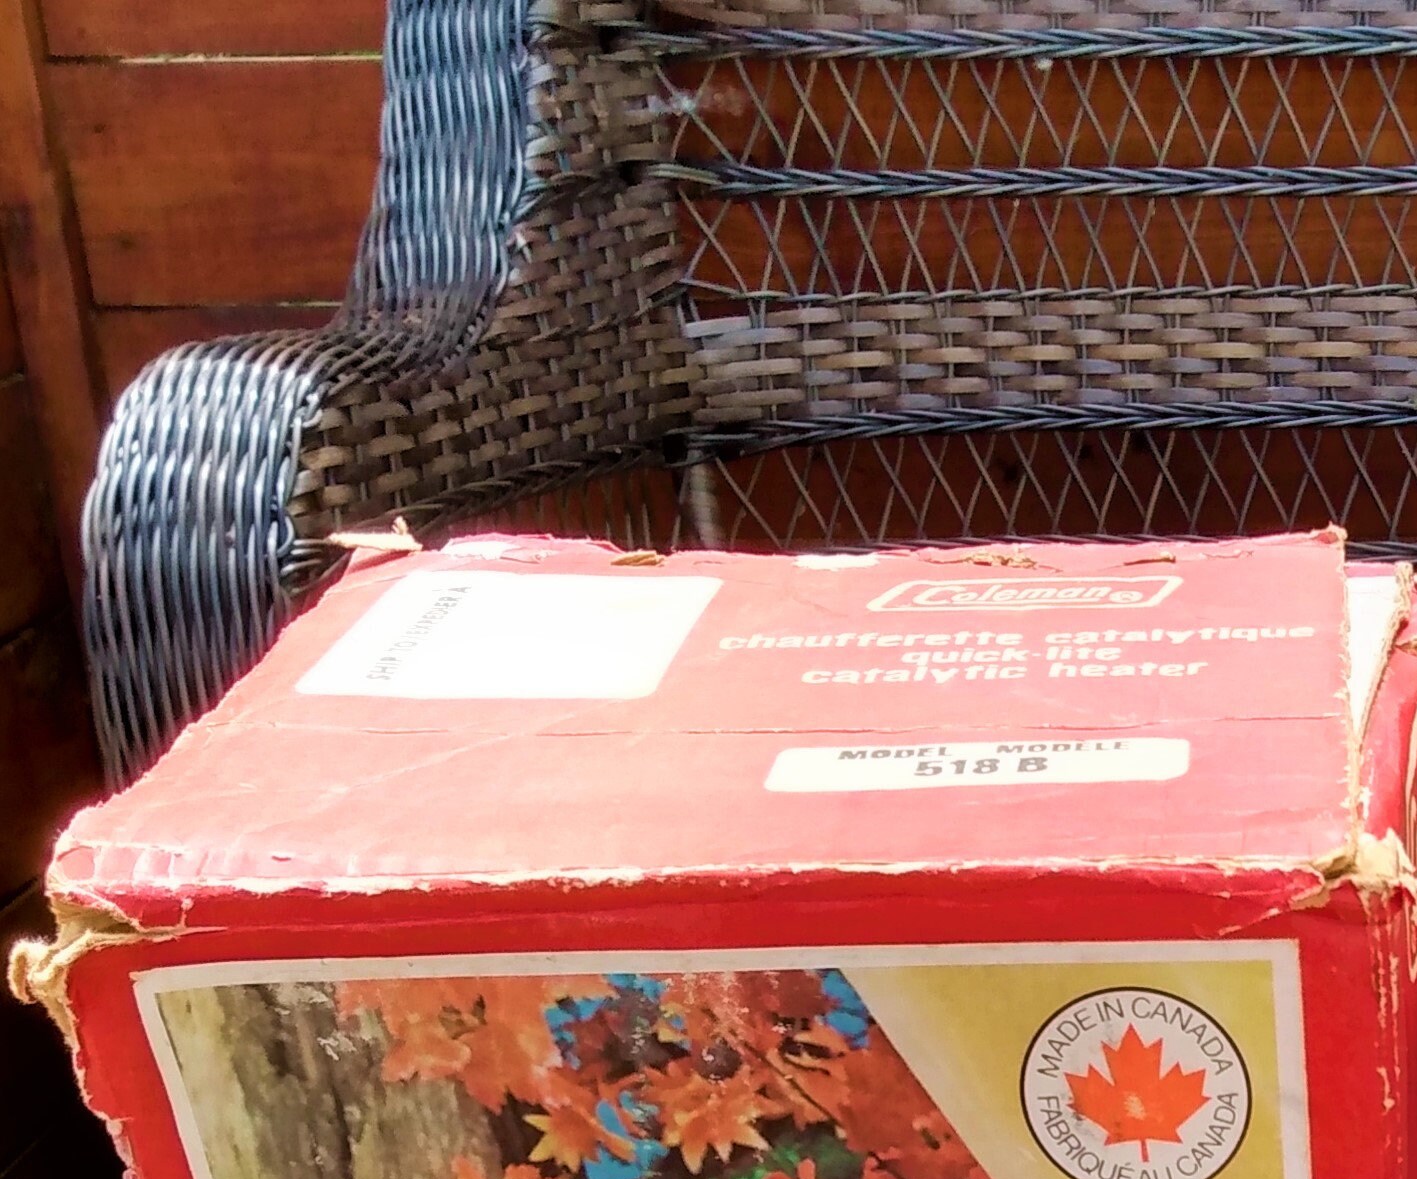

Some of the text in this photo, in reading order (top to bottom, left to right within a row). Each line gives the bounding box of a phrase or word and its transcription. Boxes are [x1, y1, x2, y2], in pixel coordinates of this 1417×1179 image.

[718, 626, 1316, 652] chaufferette catalytique
[901, 645, 1122, 666] quick-lite
[800, 661, 1209, 685] catalytic heater
[837, 746, 952, 760] MODEL
[913, 756, 1050, 777] 518 B
[1036, 996, 1234, 1078] MADE IN CANADA
[1176, 1092, 1239, 1177] CANADA
